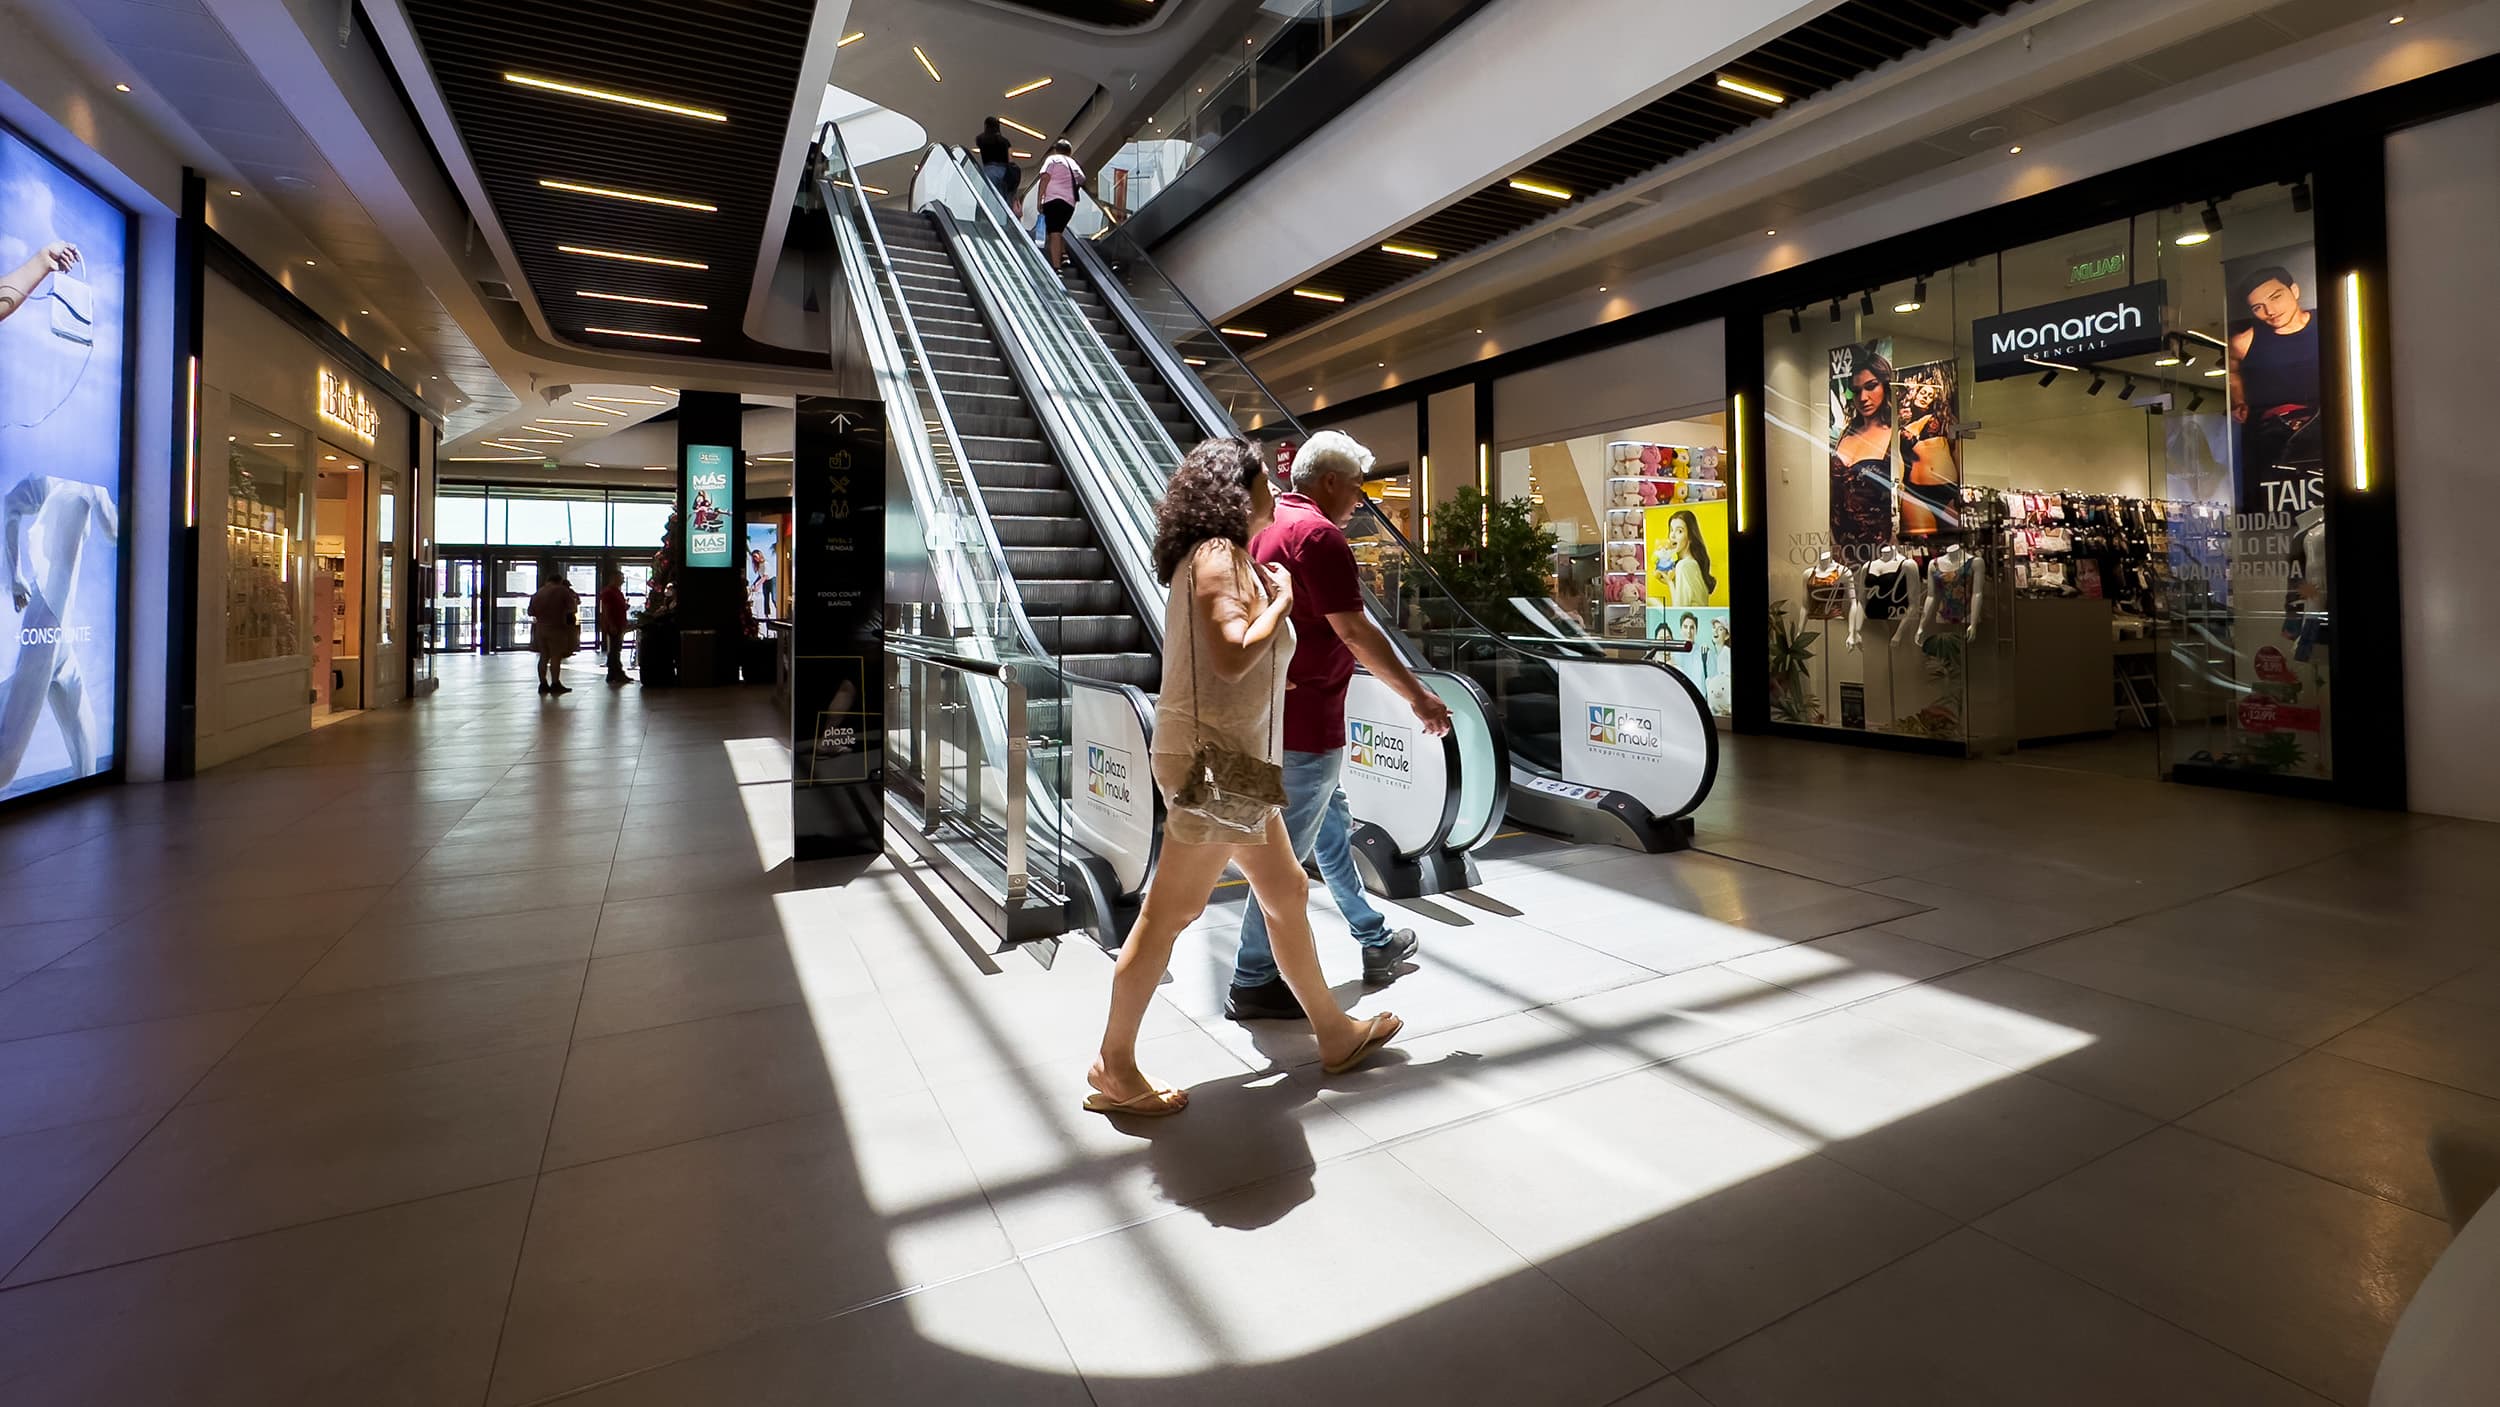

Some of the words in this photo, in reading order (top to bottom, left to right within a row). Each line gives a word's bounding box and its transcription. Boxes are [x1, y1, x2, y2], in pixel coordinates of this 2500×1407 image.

[1992, 302, 2142, 355] Monarch
[2023, 339, 2107, 362] ESENCIAL
[692, 471, 727, 486] MÁS
[2266, 535, 2291, 554] EN
[822, 735, 856, 746] maule
[824, 726, 854, 738] plaza
[1374, 731, 1404, 752] plaza
[1618, 731, 1659, 748] maule
[1105, 756, 1127, 779] plaza
[1374, 753, 1409, 773] maule
[1105, 781, 1130, 803] maule
